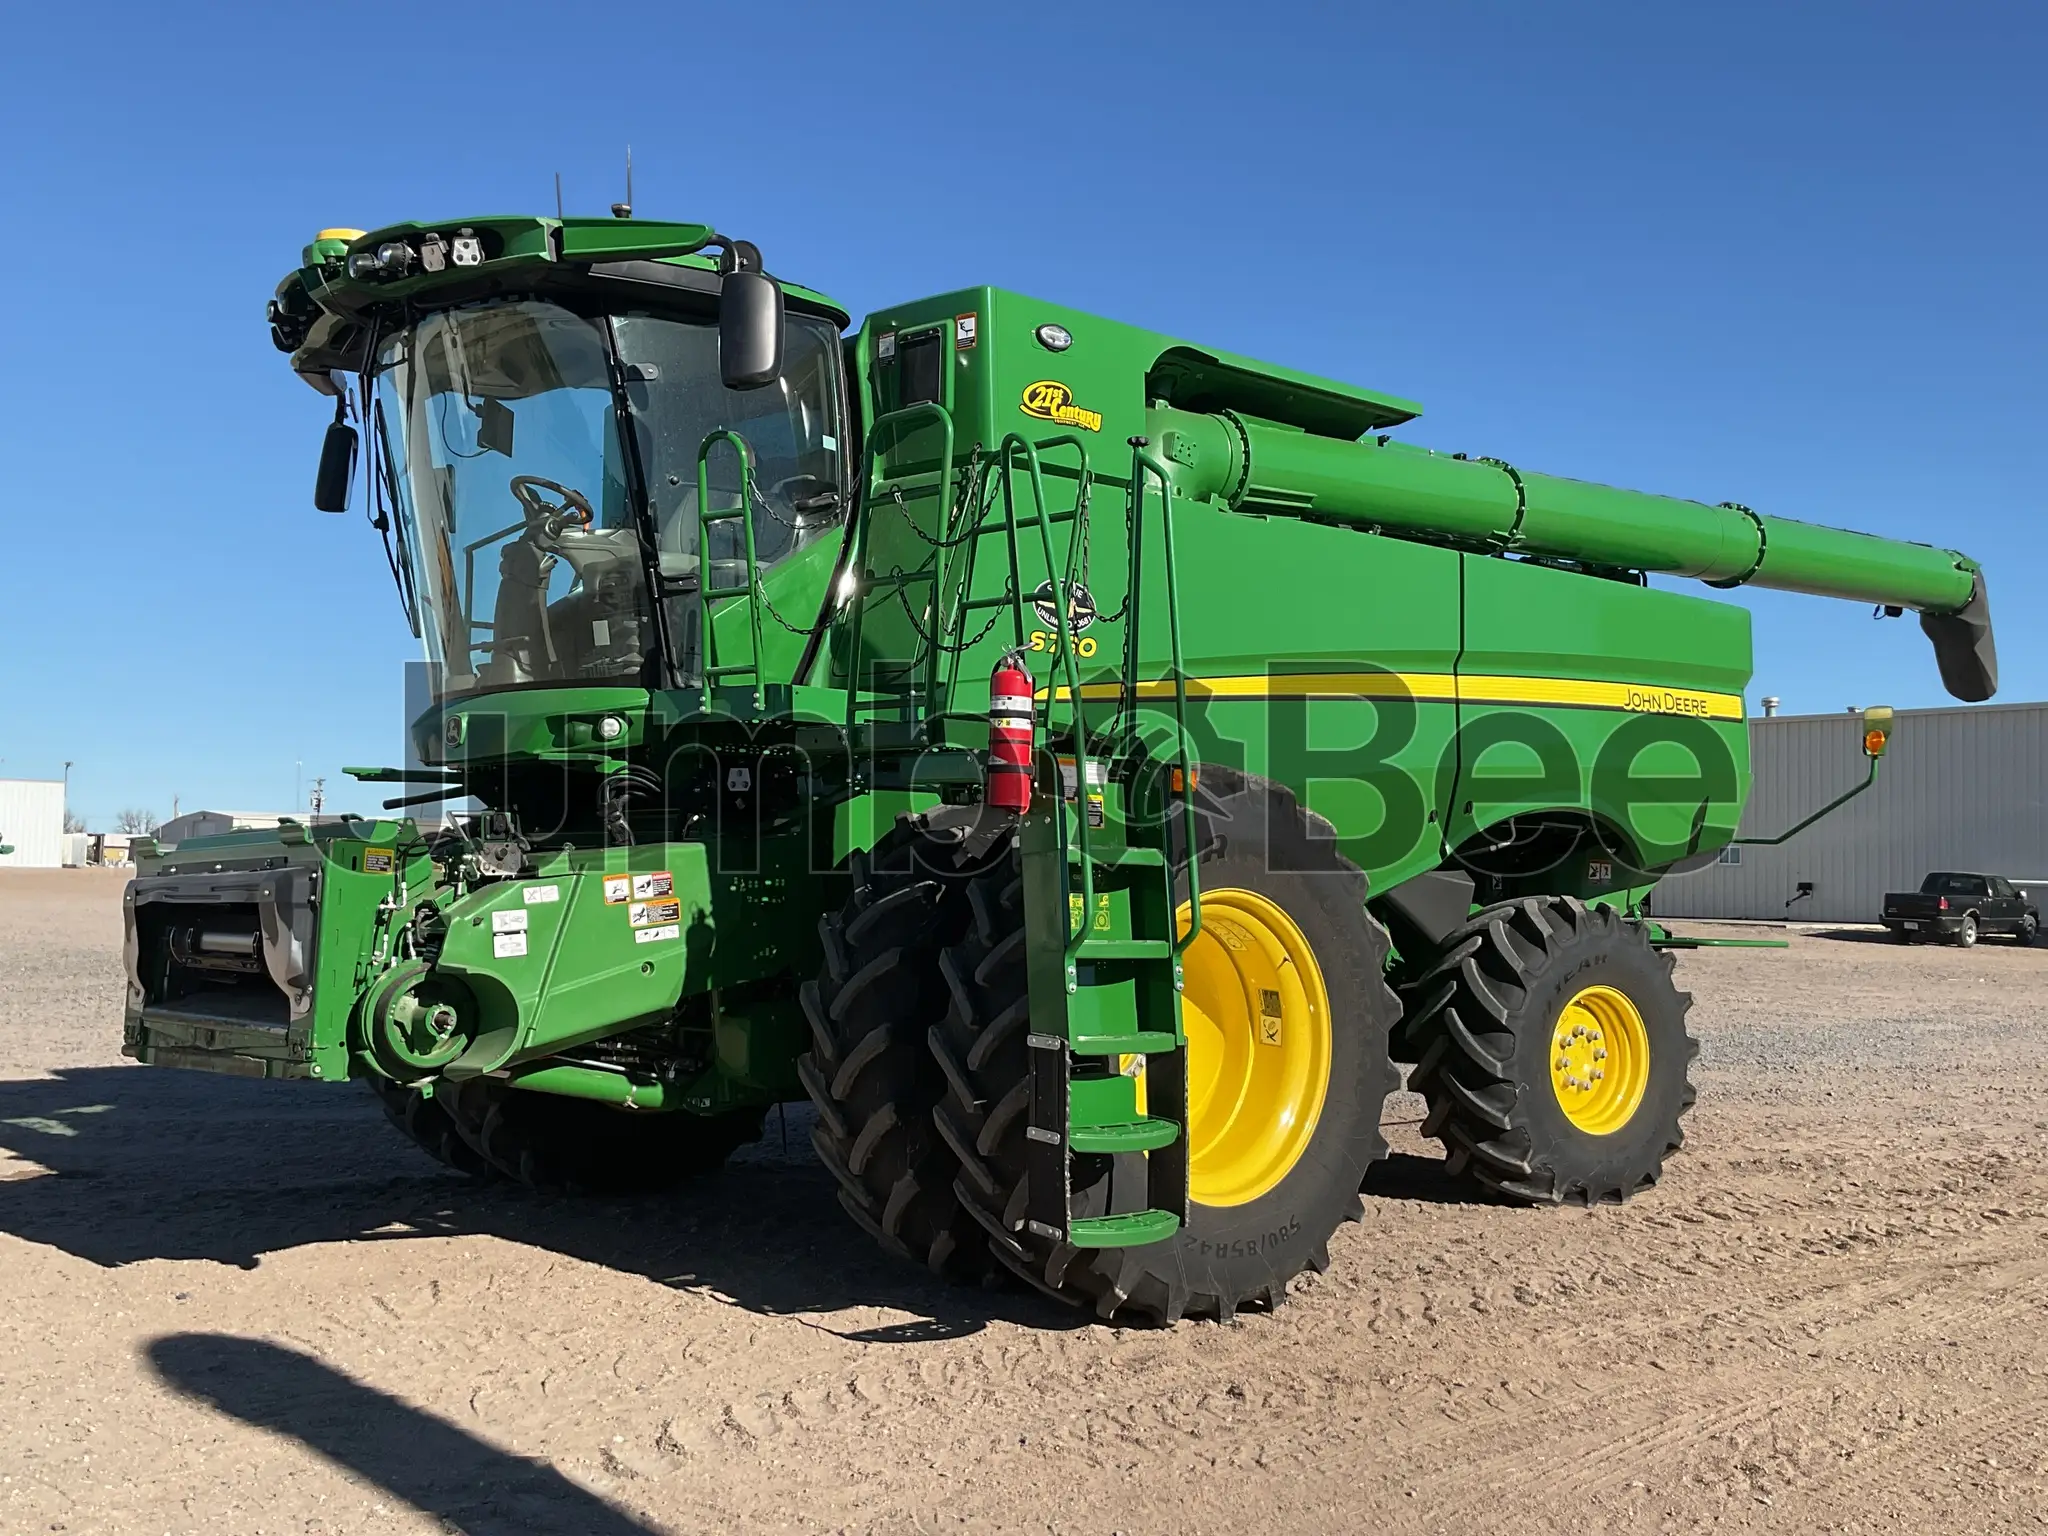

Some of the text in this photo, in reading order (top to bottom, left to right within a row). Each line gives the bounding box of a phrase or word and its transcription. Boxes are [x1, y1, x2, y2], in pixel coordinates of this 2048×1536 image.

[1031, 386, 1063, 407] 21st
[1030, 630, 1097, 657] S70
[1624, 688, 1708, 714] JOHN DEERE
